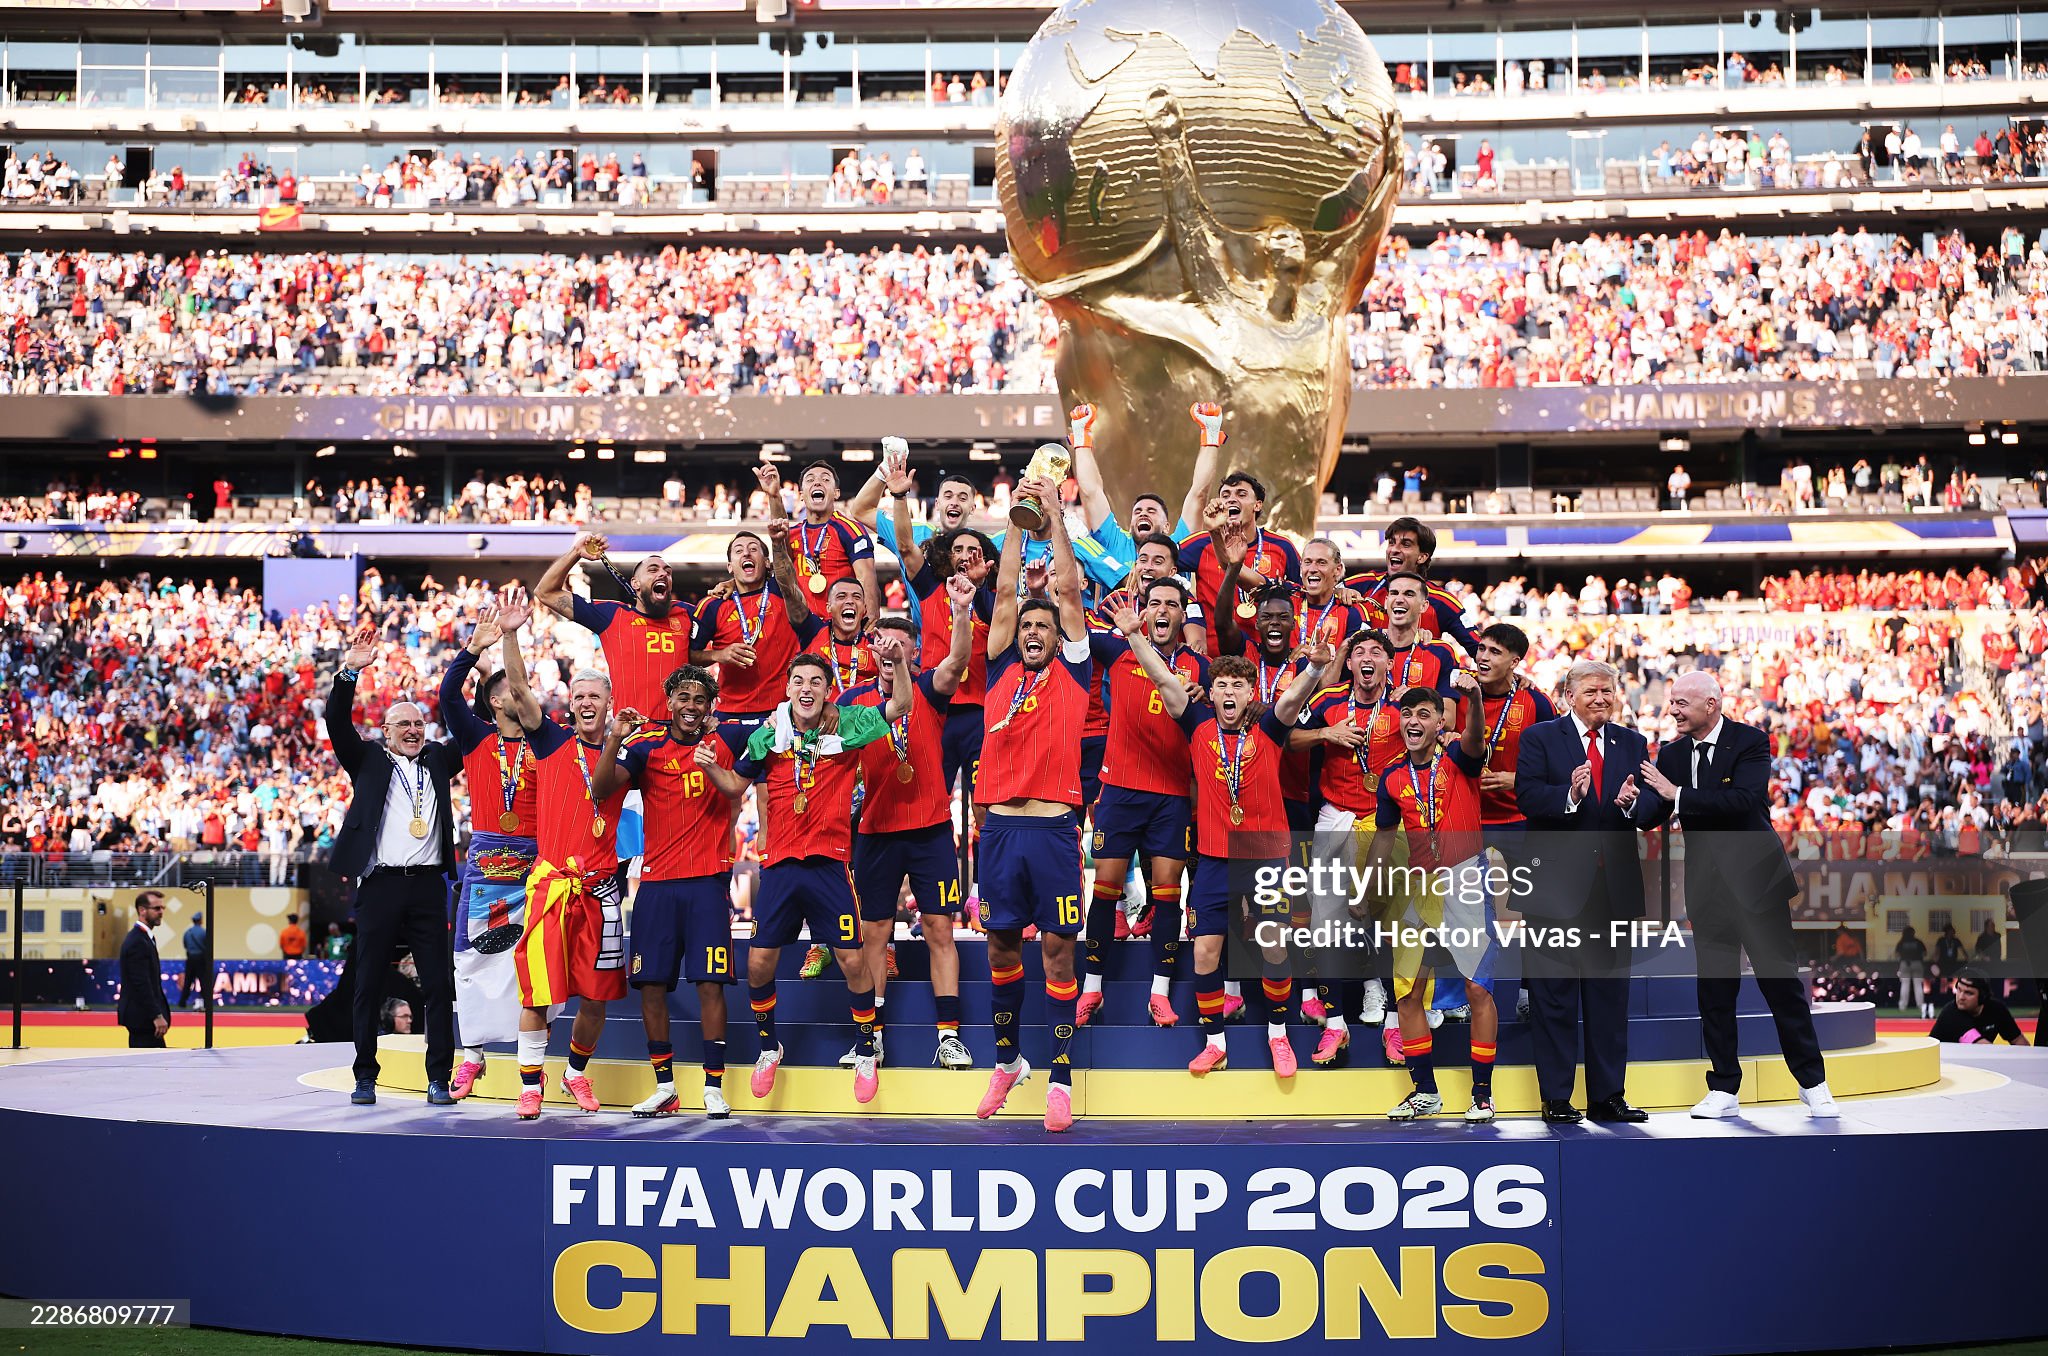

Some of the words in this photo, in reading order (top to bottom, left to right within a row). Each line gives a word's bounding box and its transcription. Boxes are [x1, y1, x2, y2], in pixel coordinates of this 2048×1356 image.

[380, 404, 604, 431] CHAMPIONS
[974, 405, 1053, 427] THE
[1584, 388, 1818, 420] CHAMPIONS
[645, 631, 675, 653] 26
[1148, 690, 1163, 714] 6
[682, 771, 704, 798] 19
[937, 879, 960, 907] 14
[1056, 895, 1079, 925] 16
[839, 914, 854, 940] 9
[706, 946, 728, 973] 19
[552, 1165, 716, 1228] FIFA
[728, 1167, 1036, 1232] WORLD
[1055, 1168, 1228, 1233] CUP
[1246, 1164, 1547, 1231] 2026
[552, 1240, 1549, 1343] CHAMPIONS
